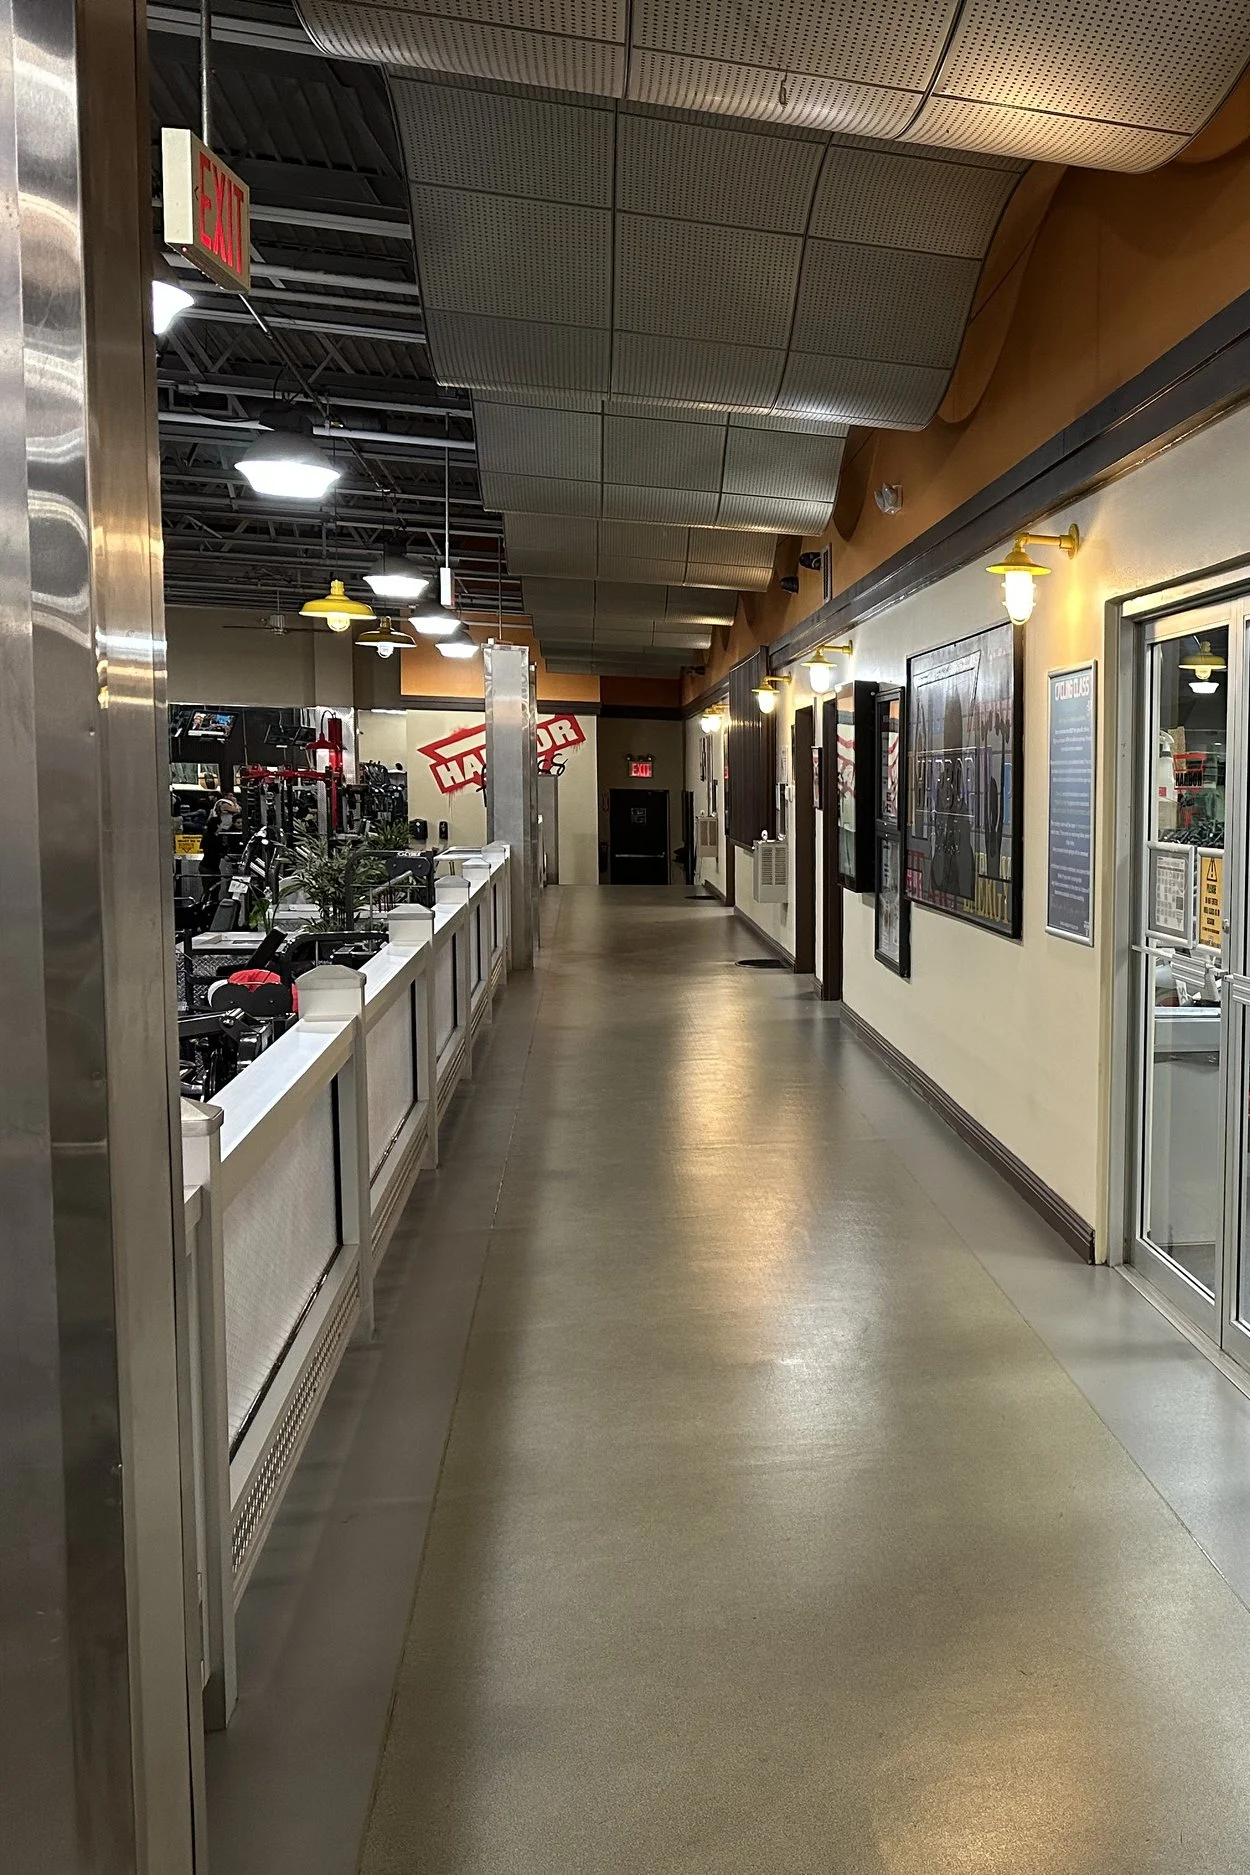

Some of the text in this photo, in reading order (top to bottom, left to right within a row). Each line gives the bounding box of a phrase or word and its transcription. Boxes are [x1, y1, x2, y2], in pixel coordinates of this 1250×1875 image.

[200, 151, 244, 276] EXIT
[1073, 676, 1090, 698] CLASS
[436, 719, 579, 789] HAOR
[631, 763, 652, 777] EXIT
